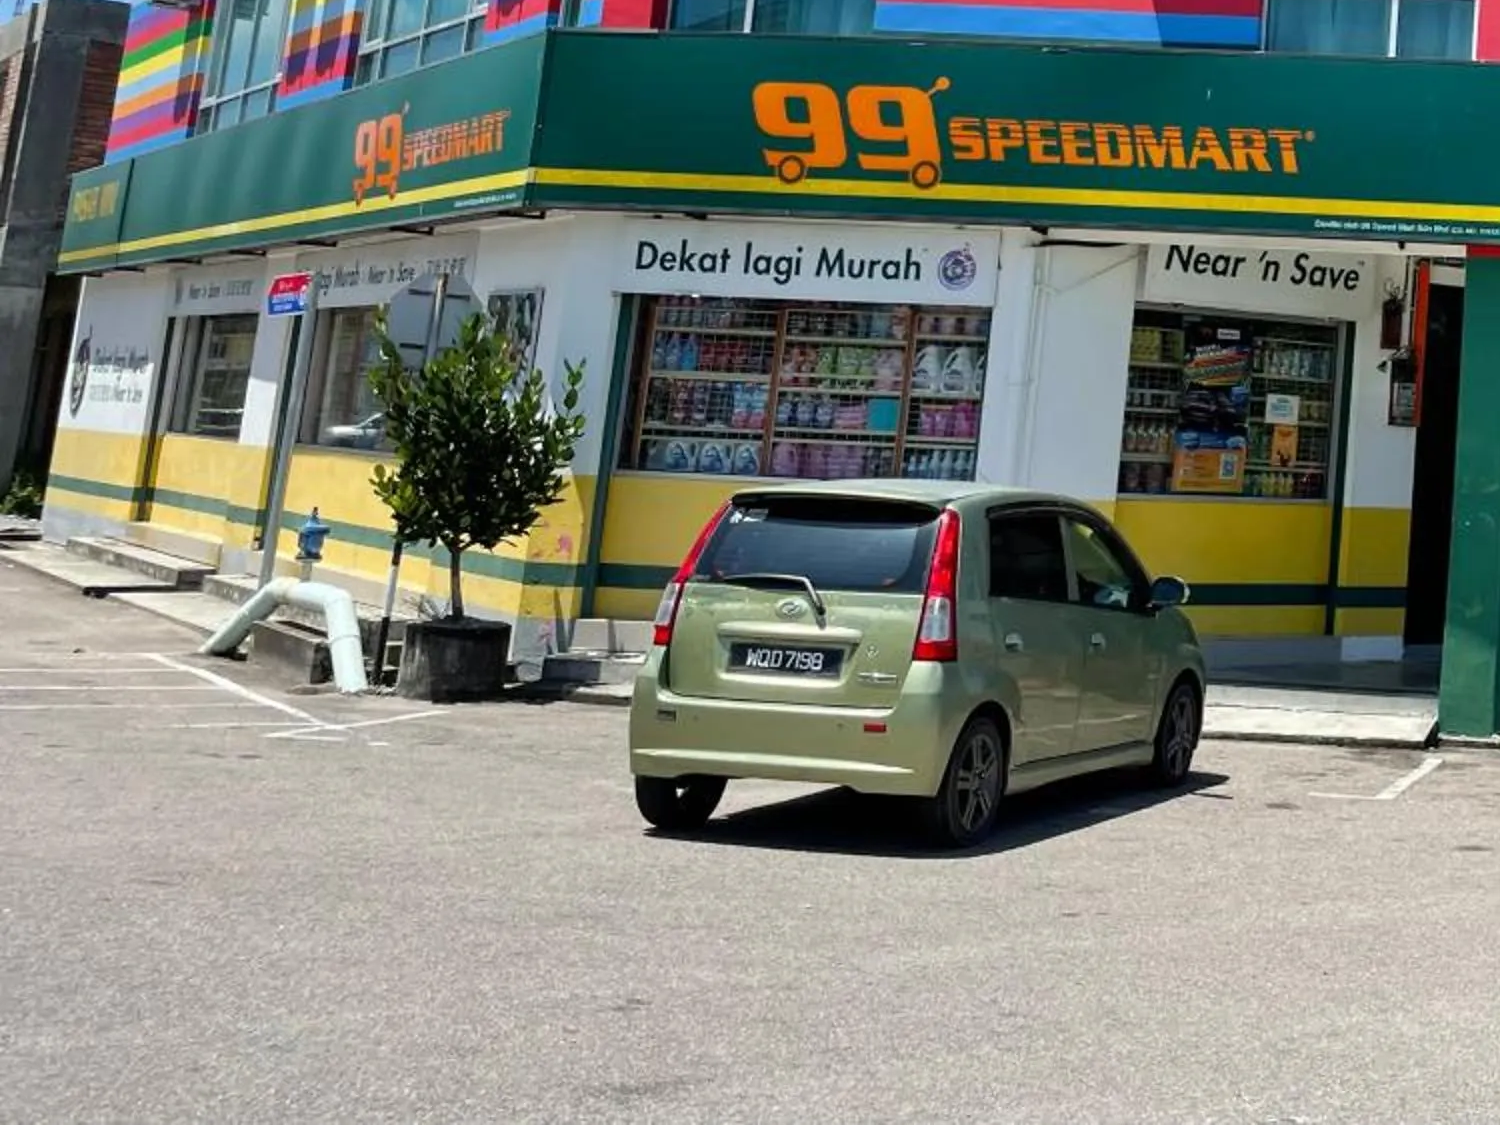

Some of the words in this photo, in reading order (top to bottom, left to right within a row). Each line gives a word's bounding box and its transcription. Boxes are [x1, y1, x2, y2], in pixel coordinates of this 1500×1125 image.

[354, 105, 405, 206] 99
[402, 108, 512, 171] SPEEDMART
[752, 80, 945, 189] 99
[948, 116, 1303, 174] SPEEDMART
[634, 238, 731, 274] Dekat
[743, 241, 804, 285] lagi
[815, 246, 922, 281] Murah
[1163, 243, 1246, 278] Near
[1257, 250, 1280, 282] 'n
[1289, 252, 1361, 291] Save
[745, 647, 783, 668] WQD
[785, 649, 824, 671] 7198
